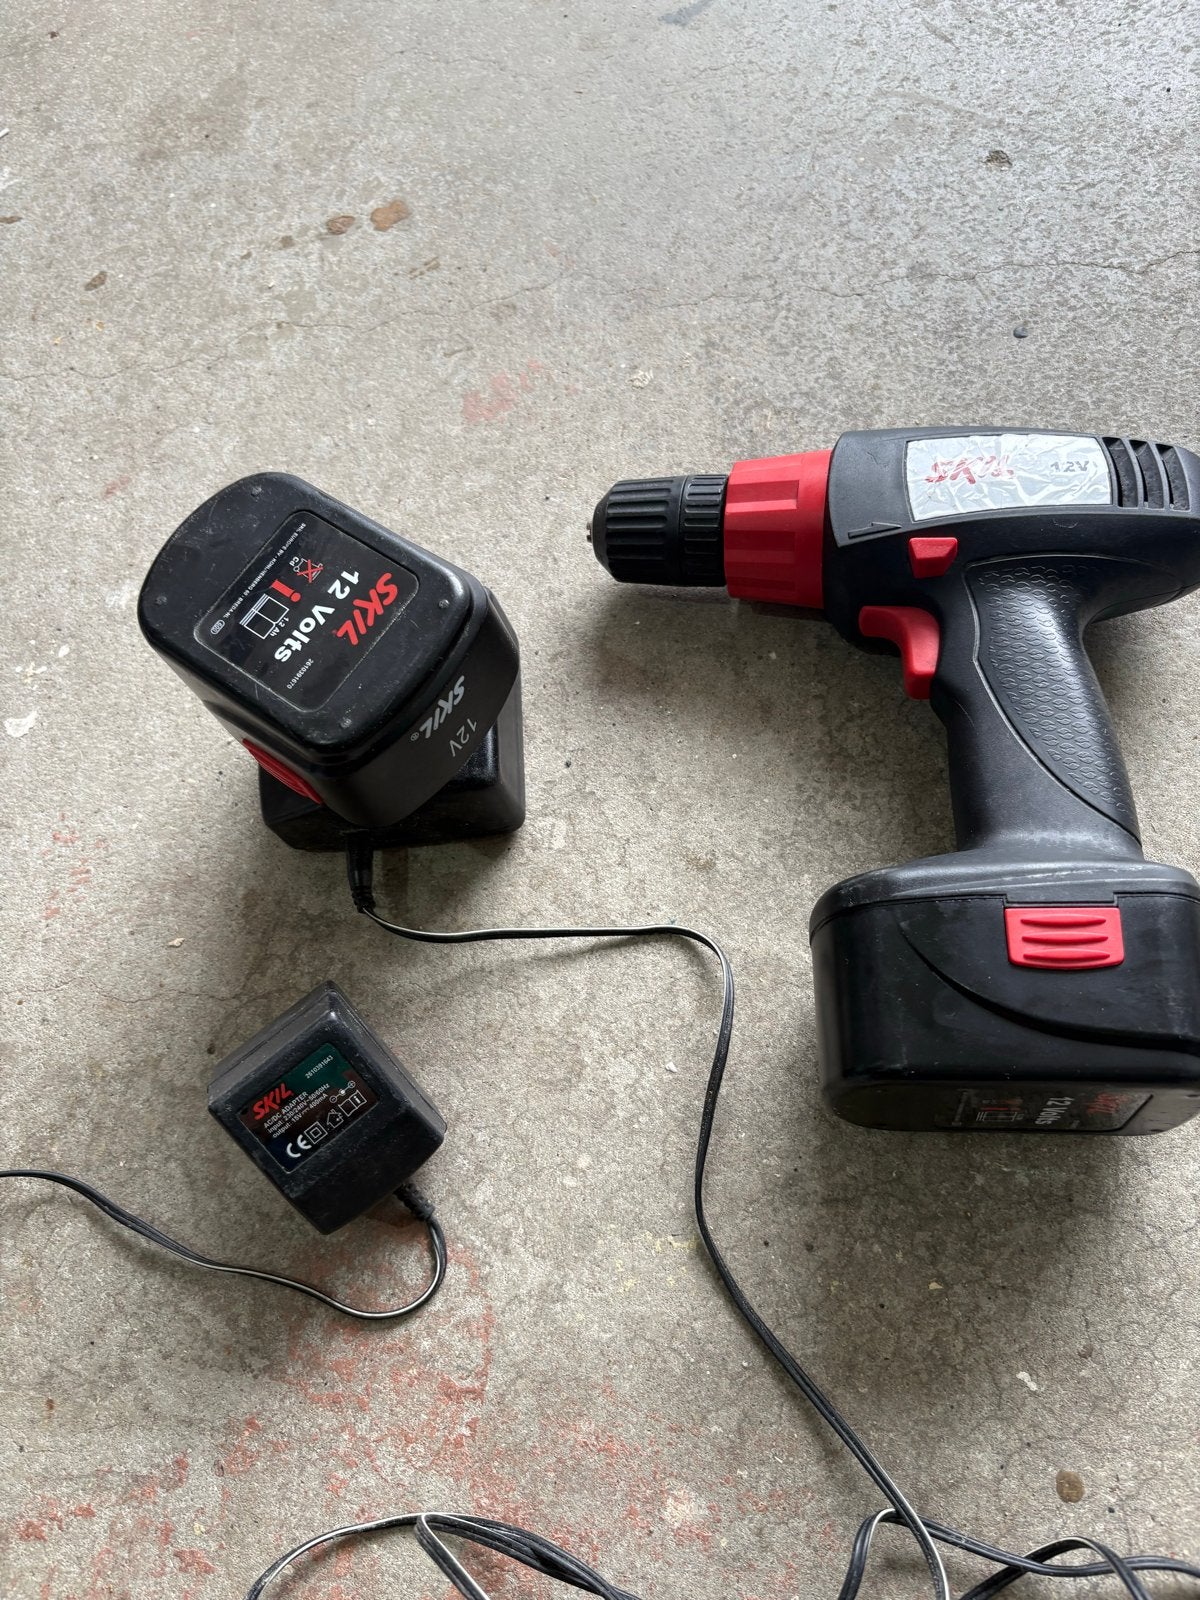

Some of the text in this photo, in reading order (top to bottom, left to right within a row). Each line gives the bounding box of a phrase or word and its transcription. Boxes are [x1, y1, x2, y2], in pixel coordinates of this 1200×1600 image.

[289, 556, 299, 567] Cd
[269, 617, 289, 637] 1.2 Ah
[274, 570, 359, 663] 12 Volts
[335, 572, 398, 646] SKIL
[449, 718, 477, 757] 12V
[253, 1083, 293, 1120] SKIL
[263, 1091, 309, 1129] AC/DC ADAPTER
